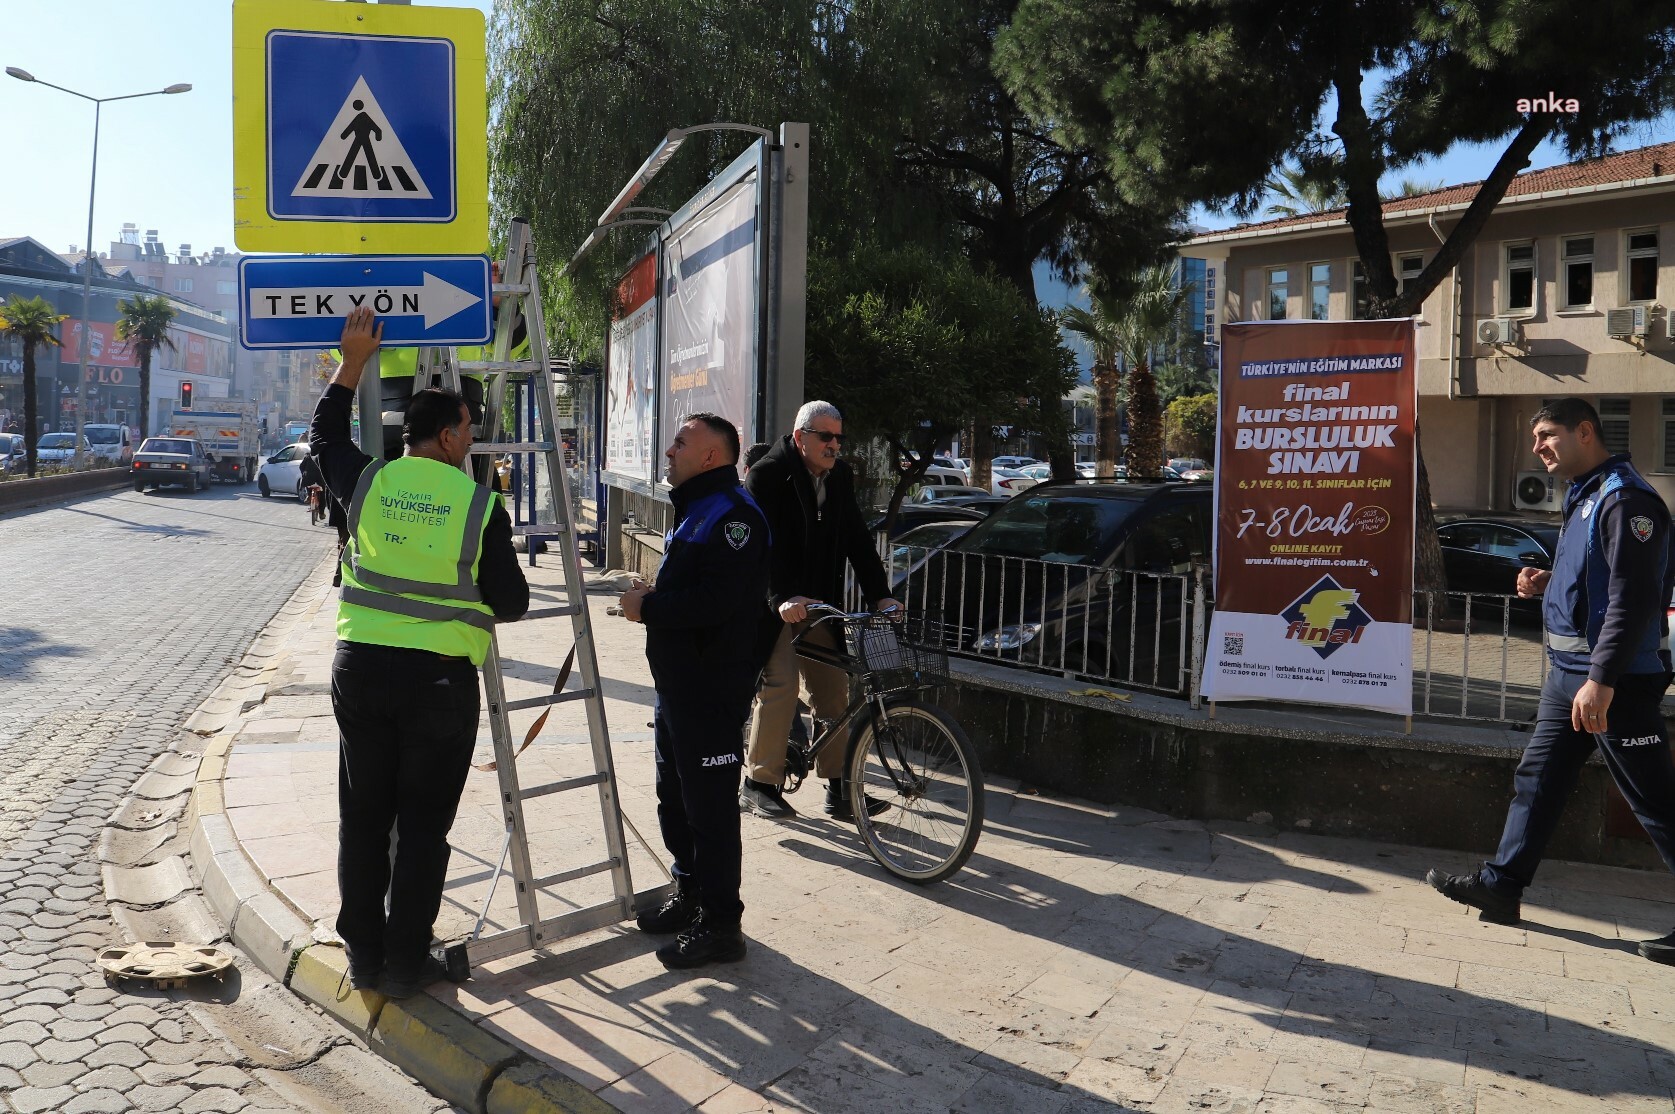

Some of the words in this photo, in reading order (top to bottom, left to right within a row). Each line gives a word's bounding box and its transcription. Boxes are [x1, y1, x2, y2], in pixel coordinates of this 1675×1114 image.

[265, 294, 334, 316] TEK
[349, 289, 419, 313] YÖN
[85, 366, 123, 384] FLO
[1241, 360, 1308, 376] TÜRKİYE'NİN
[1309, 358, 1349, 373] EĞİTİM
[1350, 357, 1403, 371] MARKASI
[1283, 381, 1350, 402] final
[1236, 404, 1398, 423] kurslarının
[1235, 424, 1398, 450] BURSLULUK
[1267, 450, 1360, 475] SINAVI
[1250, 480, 1257, 489] 7
[1259, 480, 1273, 489] VE
[1316, 479, 1364, 489] SINIFLAR
[1366, 477, 1392, 491] İÇİN
[1289, 501, 1354, 537] Ocak
[1270, 544, 1309, 553] ONLINE
[1310, 545, 1343, 553] KAYIT
[1245, 556, 1369, 568] www.finalegitim.com.tr
[1285, 620, 1366, 645] final
[1242, 661, 1257, 670] final
[1257, 663, 1271, 671] kurs
[1297, 666, 1311, 674] final
[1312, 667, 1326, 675] kurs
[1368, 671, 1382, 679] final
[1383, 672, 1397, 681] kurs
[1621, 734, 1662, 747] ZABITA
[701, 753, 739, 767] ZABITA
